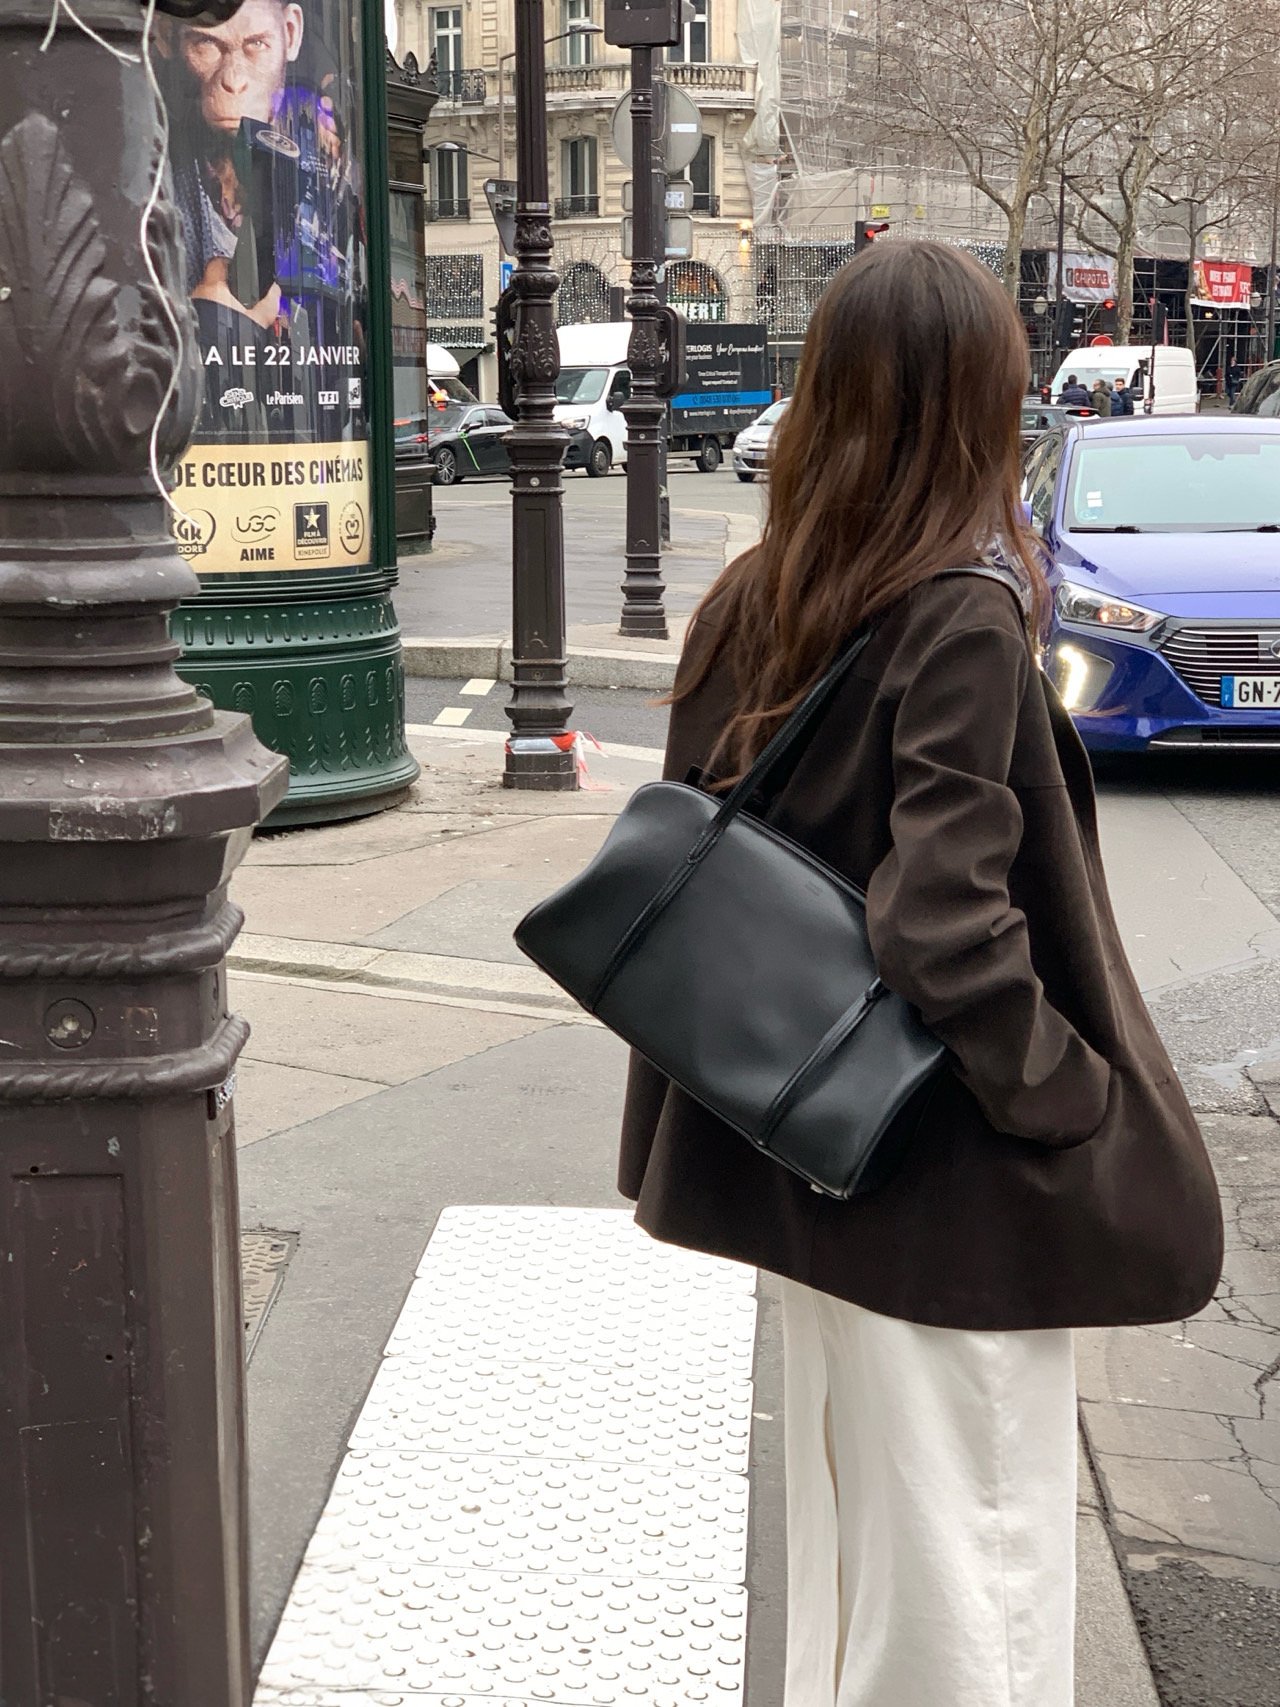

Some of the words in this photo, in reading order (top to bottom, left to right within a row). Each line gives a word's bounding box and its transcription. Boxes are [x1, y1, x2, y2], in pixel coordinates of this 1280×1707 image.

[1075, 272, 1108, 285] CHIPOTLE
[232, 346, 256, 366] LE
[264, 346, 291, 366] 22
[296, 346, 361, 366] JANVIER
[716, 343, 728, 356] Your
[266, 394, 274, 405] Le
[274, 391, 304, 405] Parisien
[175, 462, 197, 488] DE
[202, 461, 266, 488] CŒUR
[271, 458, 305, 486] DES
[309, 454, 363, 484] CINÉMAS
[236, 515, 276, 533] UGC
[240, 548, 275, 561] AIME
[1238, 680, 1280, 703] GN-7
